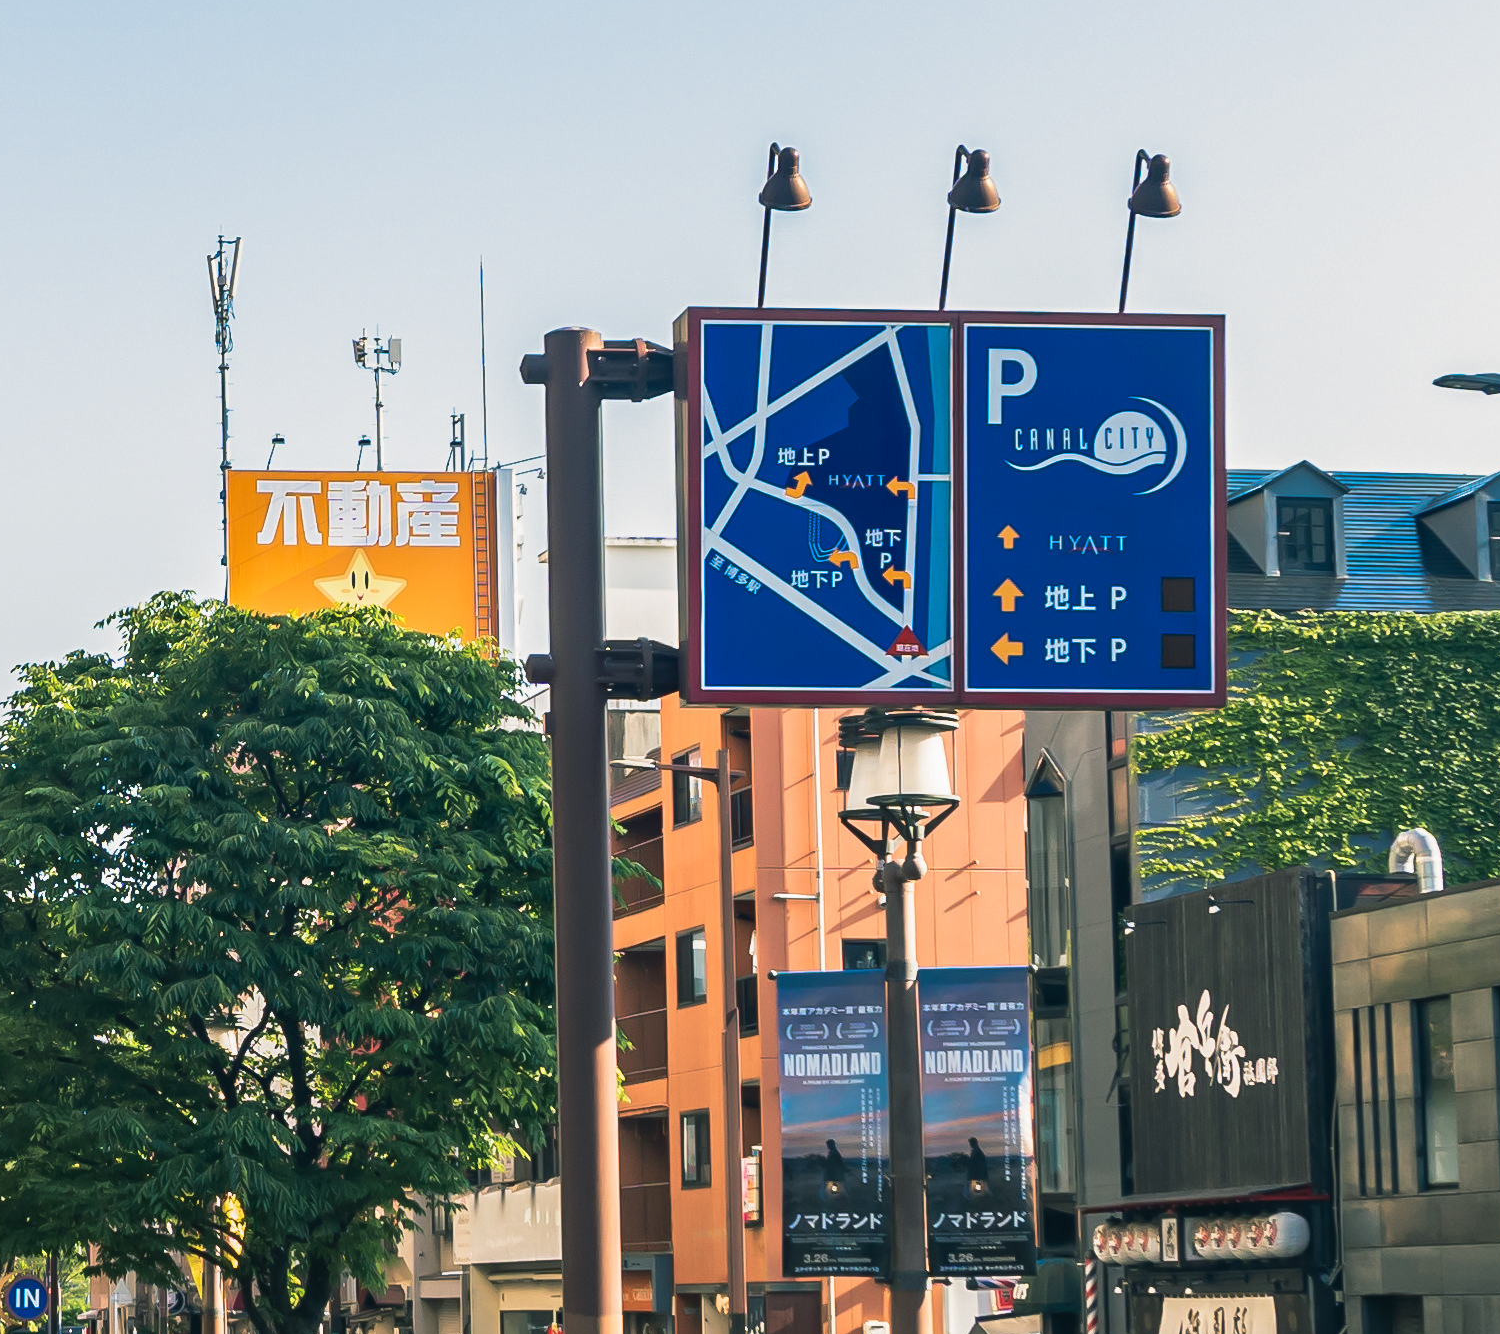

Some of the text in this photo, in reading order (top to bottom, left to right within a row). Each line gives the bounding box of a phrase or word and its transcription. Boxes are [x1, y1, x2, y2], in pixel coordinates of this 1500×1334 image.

[987, 348, 1038, 425] P
[1014, 426, 1154, 451] CANAL CITY
[777, 447, 830, 466] 地上P
[828, 474, 886, 489] HYATT
[256, 479, 461, 547] 不動産
[865, 529, 902, 546] 地下
[1049, 535, 1127, 555] HYATT
[724, 563, 763, 595] 博多駅
[790, 570, 843, 589] 地下P
[1044, 585, 1128, 611] 地上 P
[1044, 637, 1128, 664] 地下 P
[784, 1052, 881, 1077] NOMADLAND
[925, 1049, 1023, 1074] NOMADLAND
[789, 1212, 883, 1229] ノマドランド
[932, 1211, 1027, 1229] ノマドランド
[803, 1253, 828, 1264] 3.26
[948, 1253, 973, 1263] 3.26
[15, 1288, 40, 1309] IN
